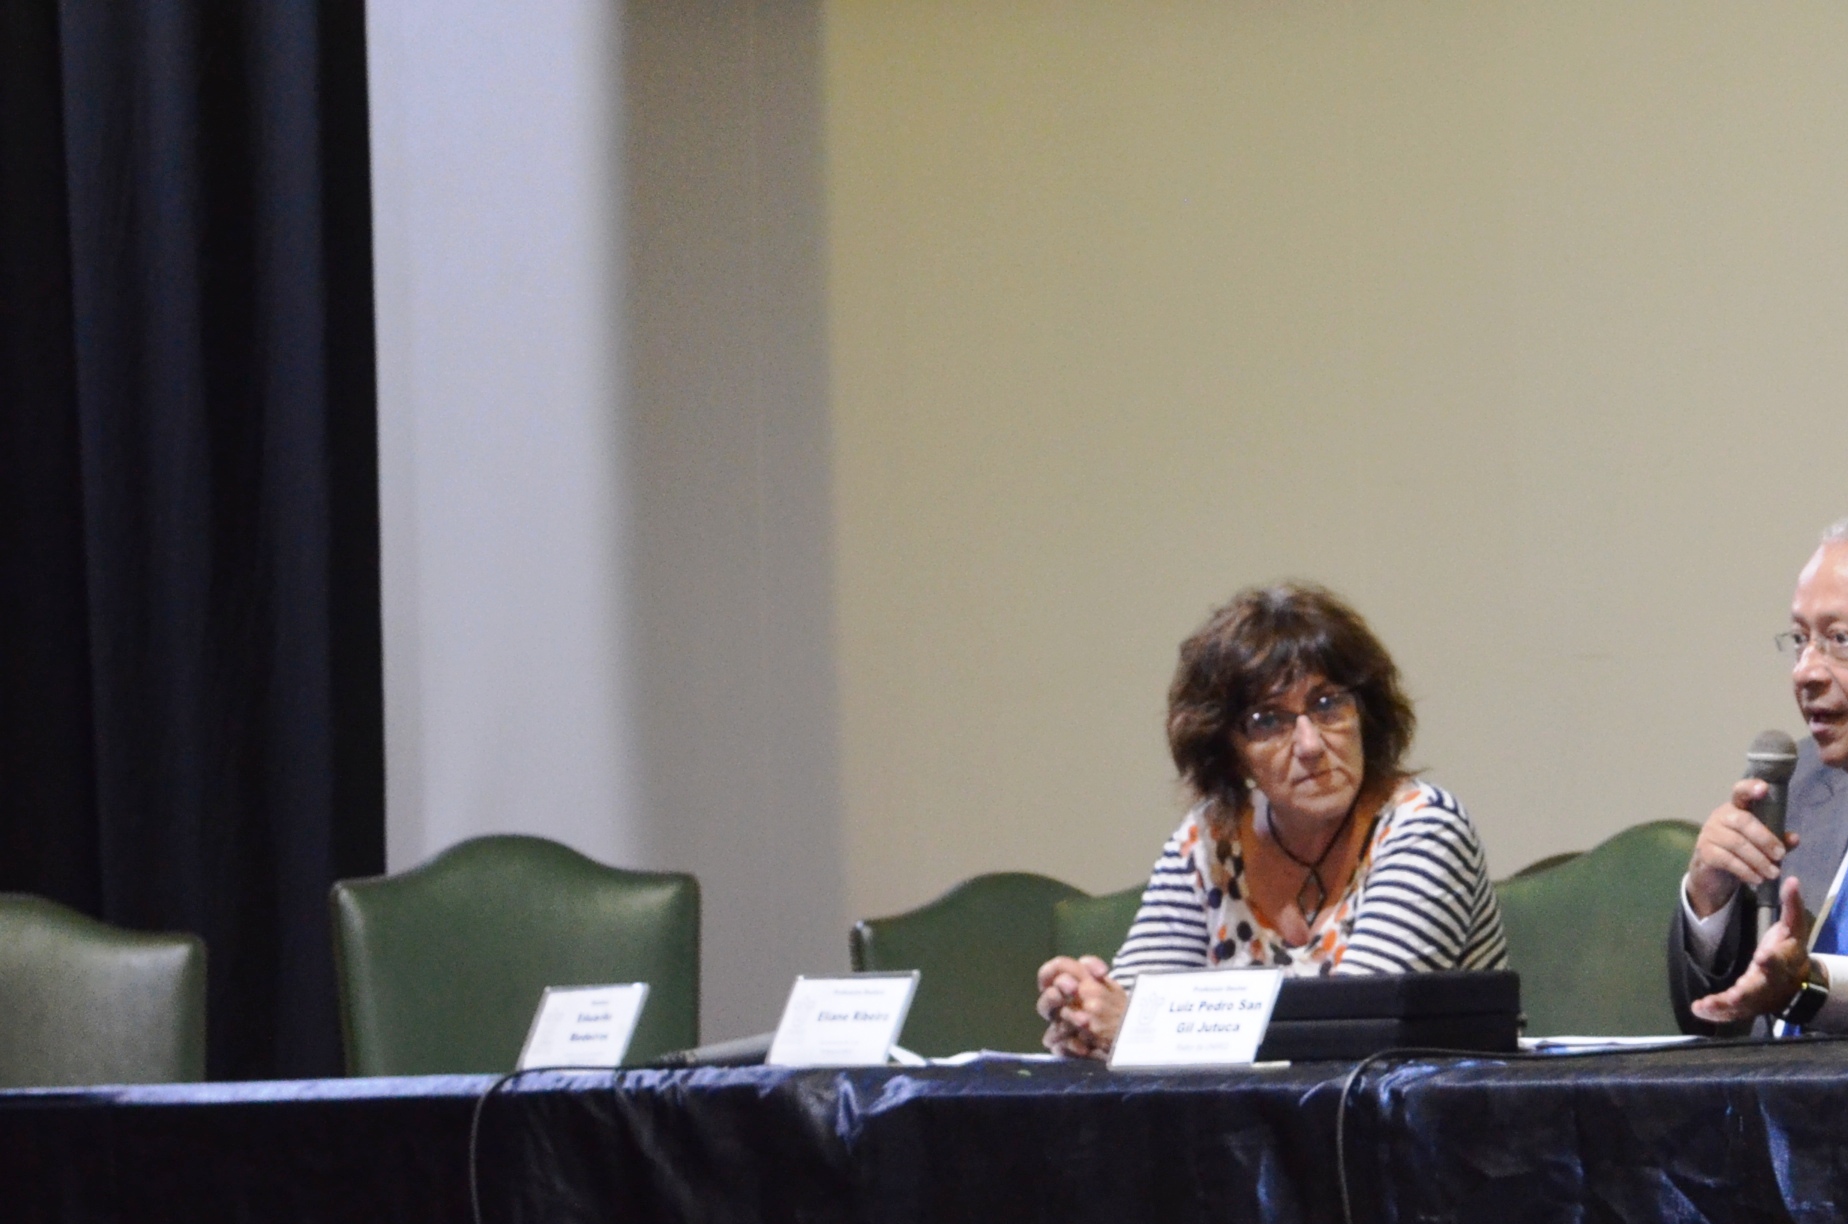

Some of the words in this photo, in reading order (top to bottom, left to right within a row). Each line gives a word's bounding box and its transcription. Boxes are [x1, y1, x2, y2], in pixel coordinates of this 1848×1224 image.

[1198, 1000, 1234, 1011] Pedro
[1238, 999, 1262, 1010] San
[1176, 1022, 1195, 1033] Gil
[1197, 1022, 1240, 1033] Jutuca
